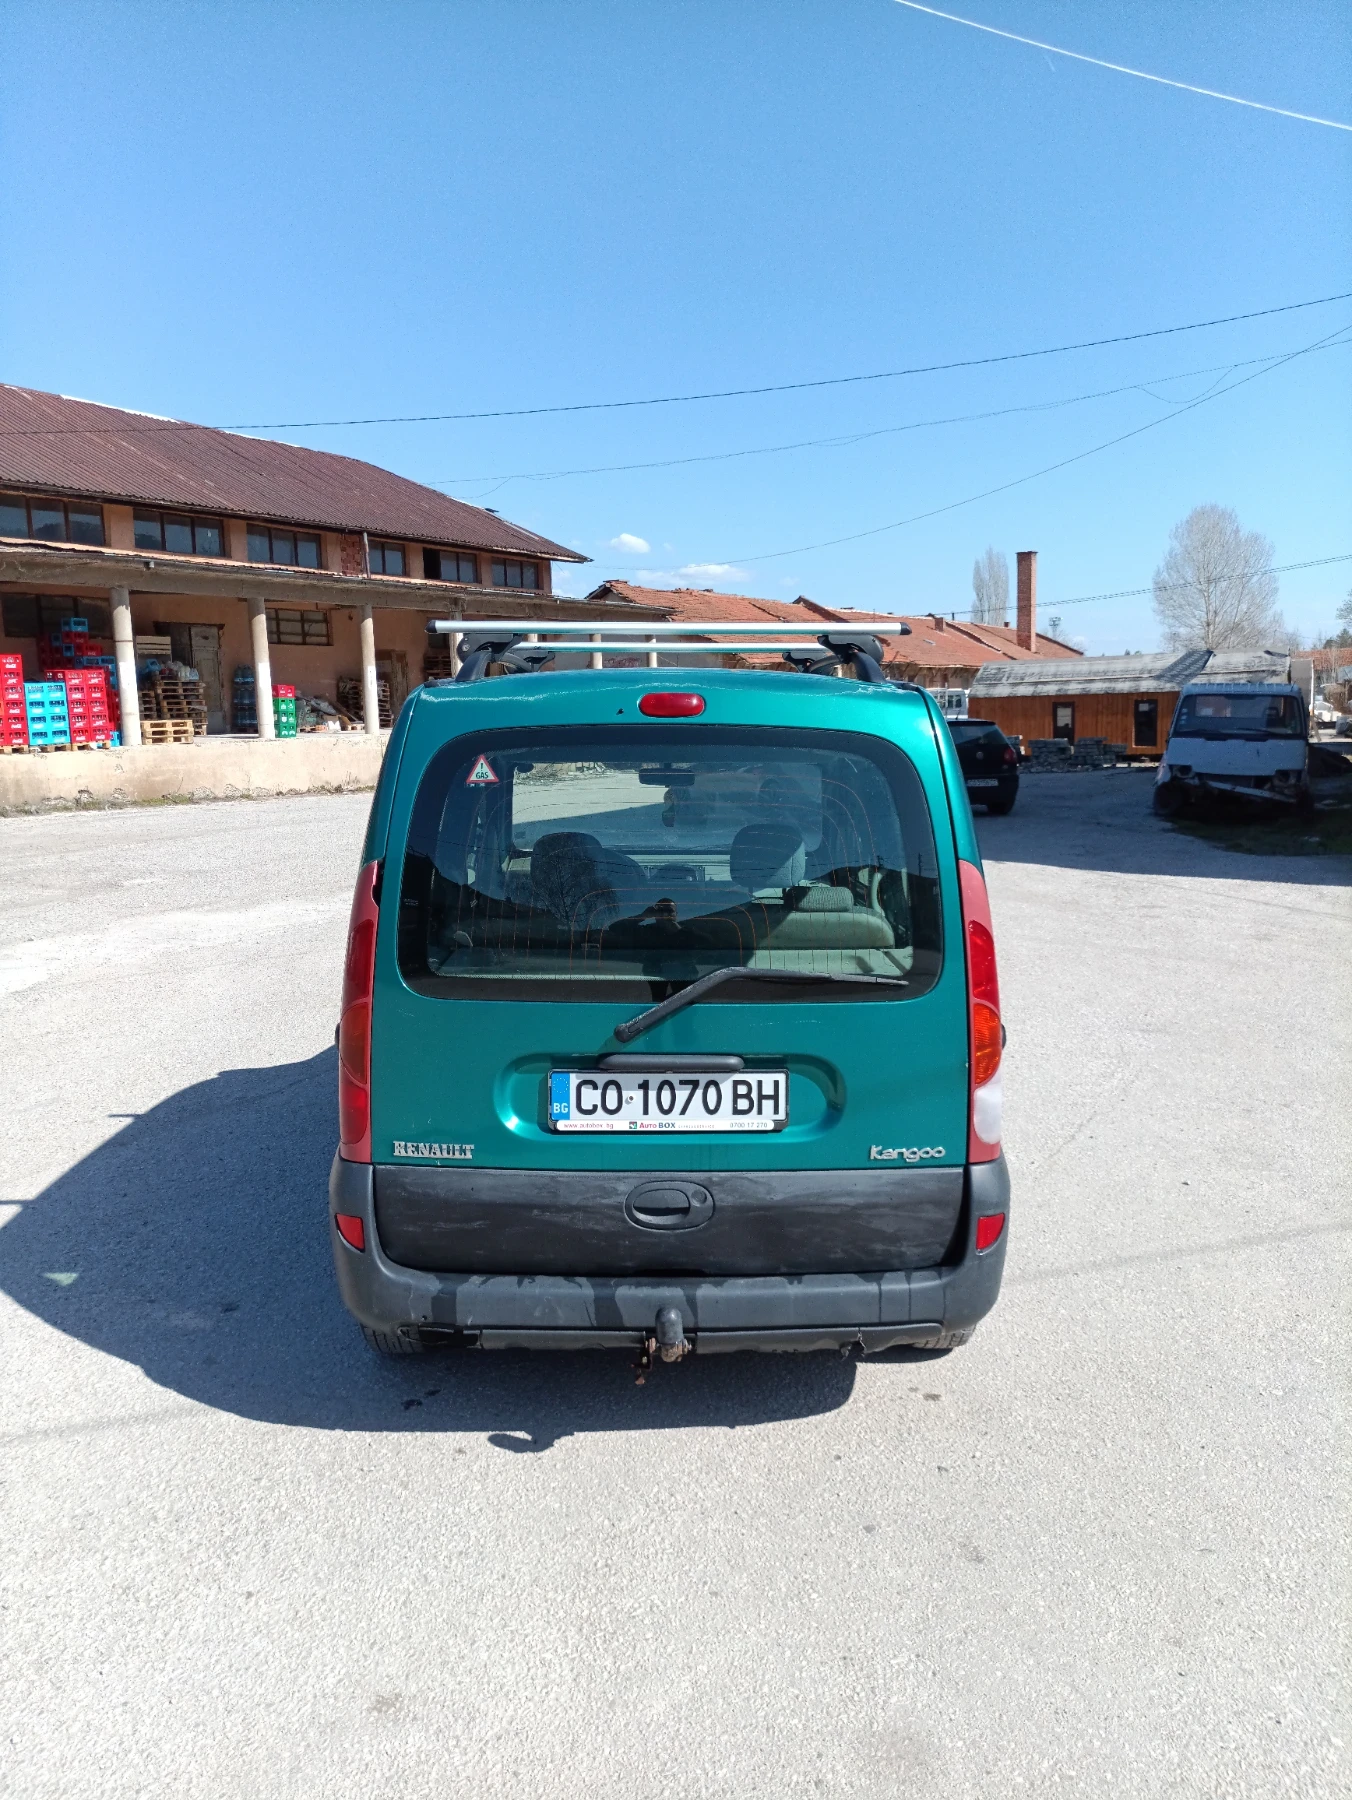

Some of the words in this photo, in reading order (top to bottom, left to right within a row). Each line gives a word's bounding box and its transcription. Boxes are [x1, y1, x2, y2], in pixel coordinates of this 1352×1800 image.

[475, 771, 489, 779] GAS
[575, 1079, 623, 1116] CO
[637, 1079, 723, 1116] 1070
[732, 1079, 780, 1116] BH
[553, 1102, 569, 1114] BG
[393, 1141, 475, 1159] RENAULT
[870, 1144, 946, 1162] Kangoo
